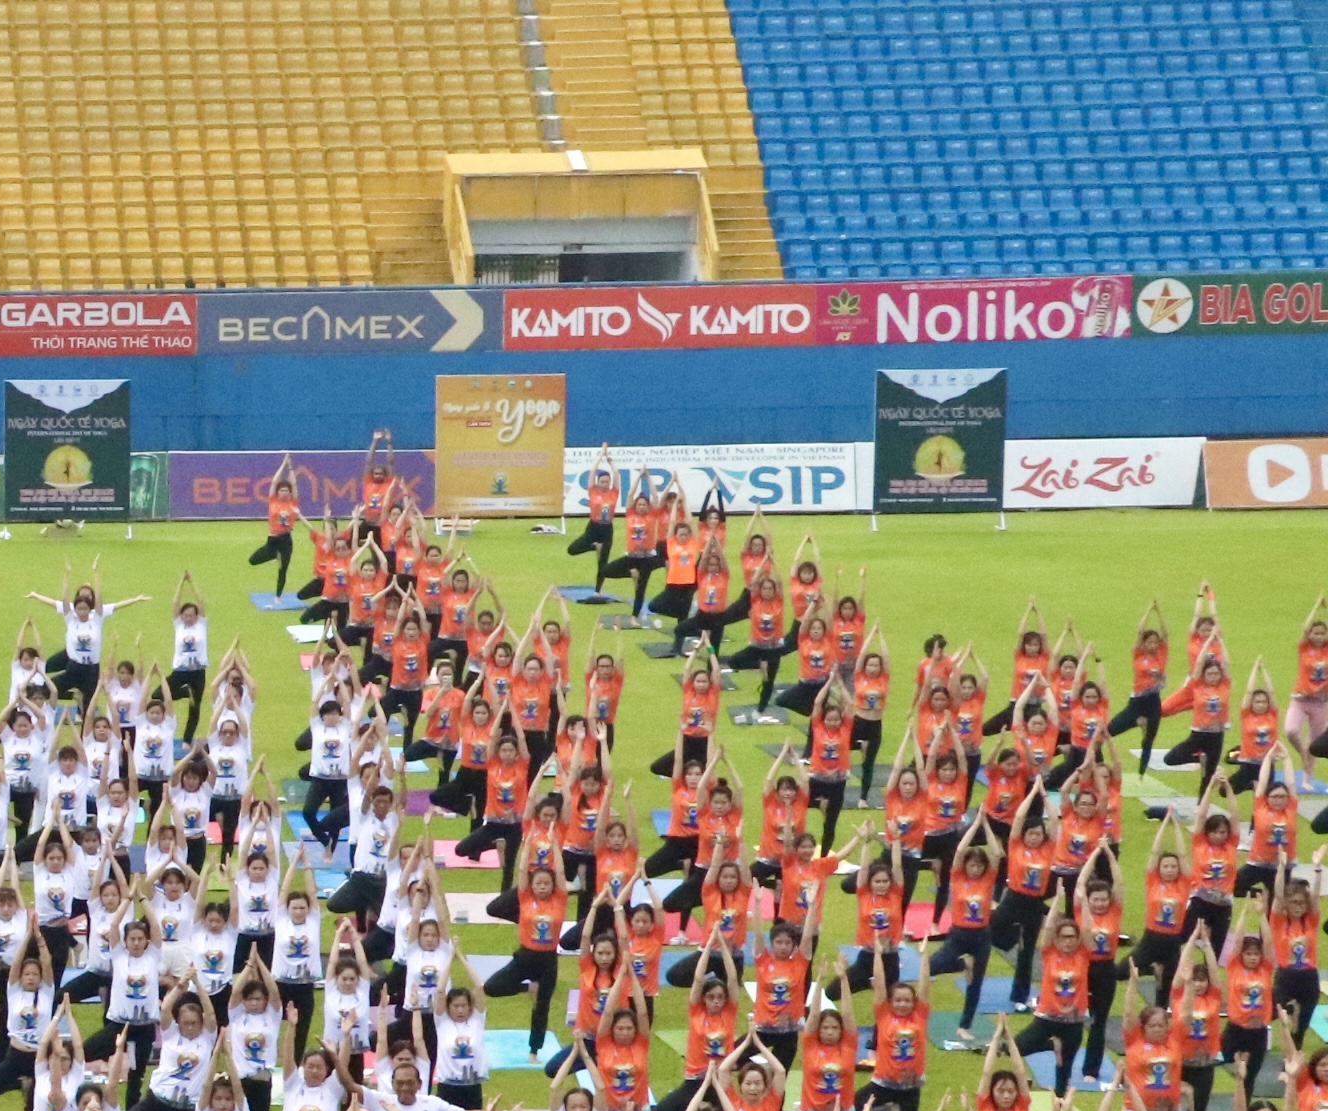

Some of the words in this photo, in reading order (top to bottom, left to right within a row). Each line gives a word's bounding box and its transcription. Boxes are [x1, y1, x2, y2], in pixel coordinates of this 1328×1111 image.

[690, 303, 811, 335] KAMITO
[877, 290, 1076, 343] Noliko
[1199, 284, 1256, 325] BIA
[1263, 282, 1328, 324] GOL
[218, 305, 425, 342] BECAMEX
[511, 306, 631, 338] KAMITO
[68, 337, 117, 349] TRANG
[152, 336, 192, 348] THAO
[93, 416, 127, 428] YOGA
[968, 406, 1003, 418] YOGA
[776, 446, 844, 454] SINGAPORE
[690, 466, 846, 505] VSIP
